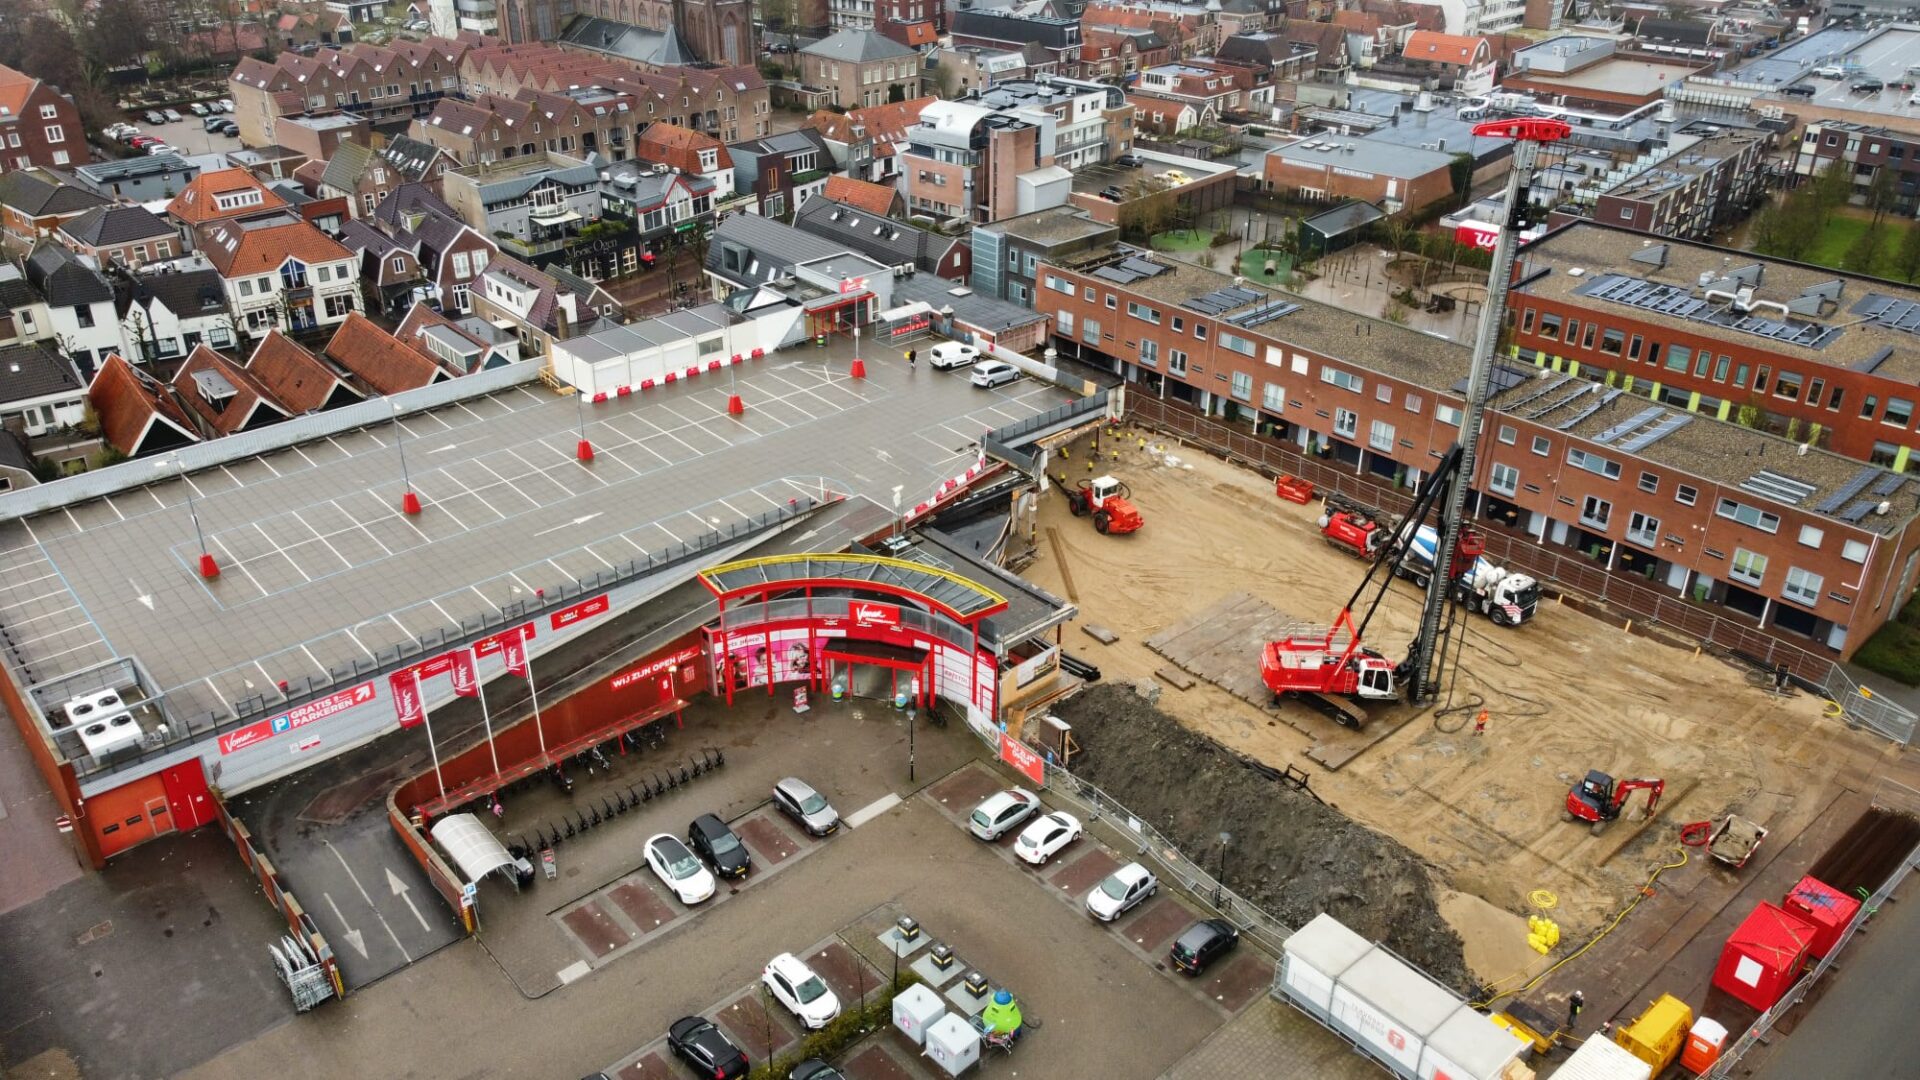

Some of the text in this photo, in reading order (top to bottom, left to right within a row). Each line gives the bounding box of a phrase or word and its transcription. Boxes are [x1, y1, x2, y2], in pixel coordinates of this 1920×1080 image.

[593, 239, 618, 252] Ogen
[612, 676, 630, 688] WIJ
[631, 667, 652, 680] ZIJN
[652, 657, 676, 671] OPEN
[290, 697, 332, 719] GRATIS
[292, 698, 353, 728] PARKEREN
[225, 731, 257, 752] Vomar
